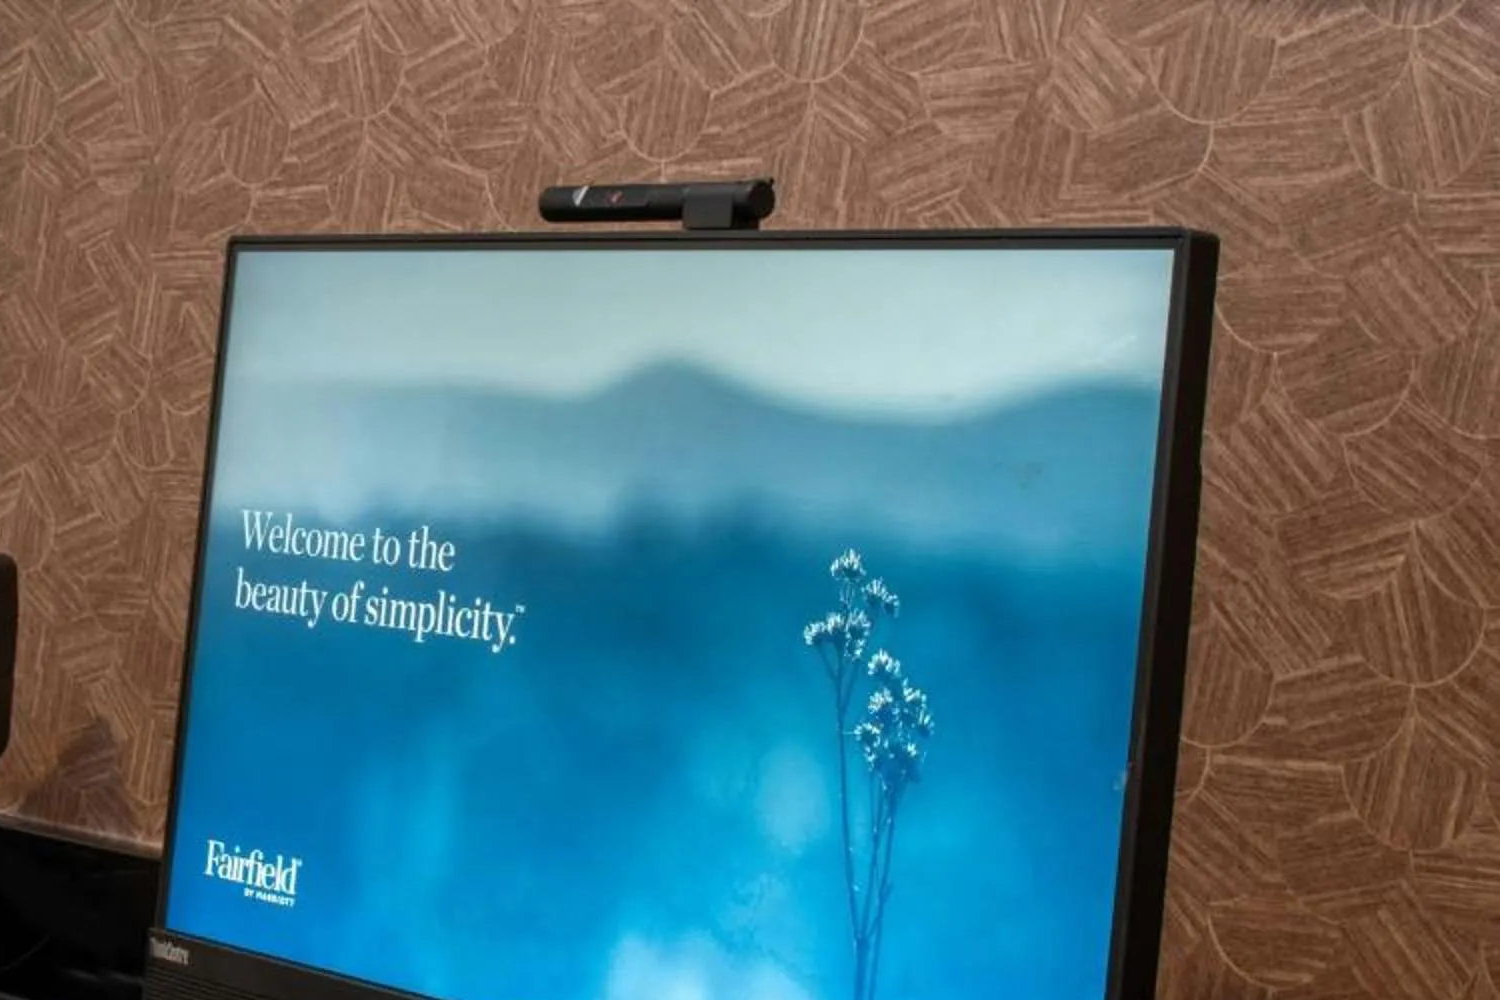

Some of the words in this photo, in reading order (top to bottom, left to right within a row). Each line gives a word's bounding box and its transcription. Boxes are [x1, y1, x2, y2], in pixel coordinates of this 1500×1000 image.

[241, 509, 365, 562] Welcome
[372, 527, 401, 566] to
[407, 525, 456, 572] the
[235, 567, 328, 629] beauty
[331, 580, 364, 624] of
[204, 839, 298, 895] Fairfield
